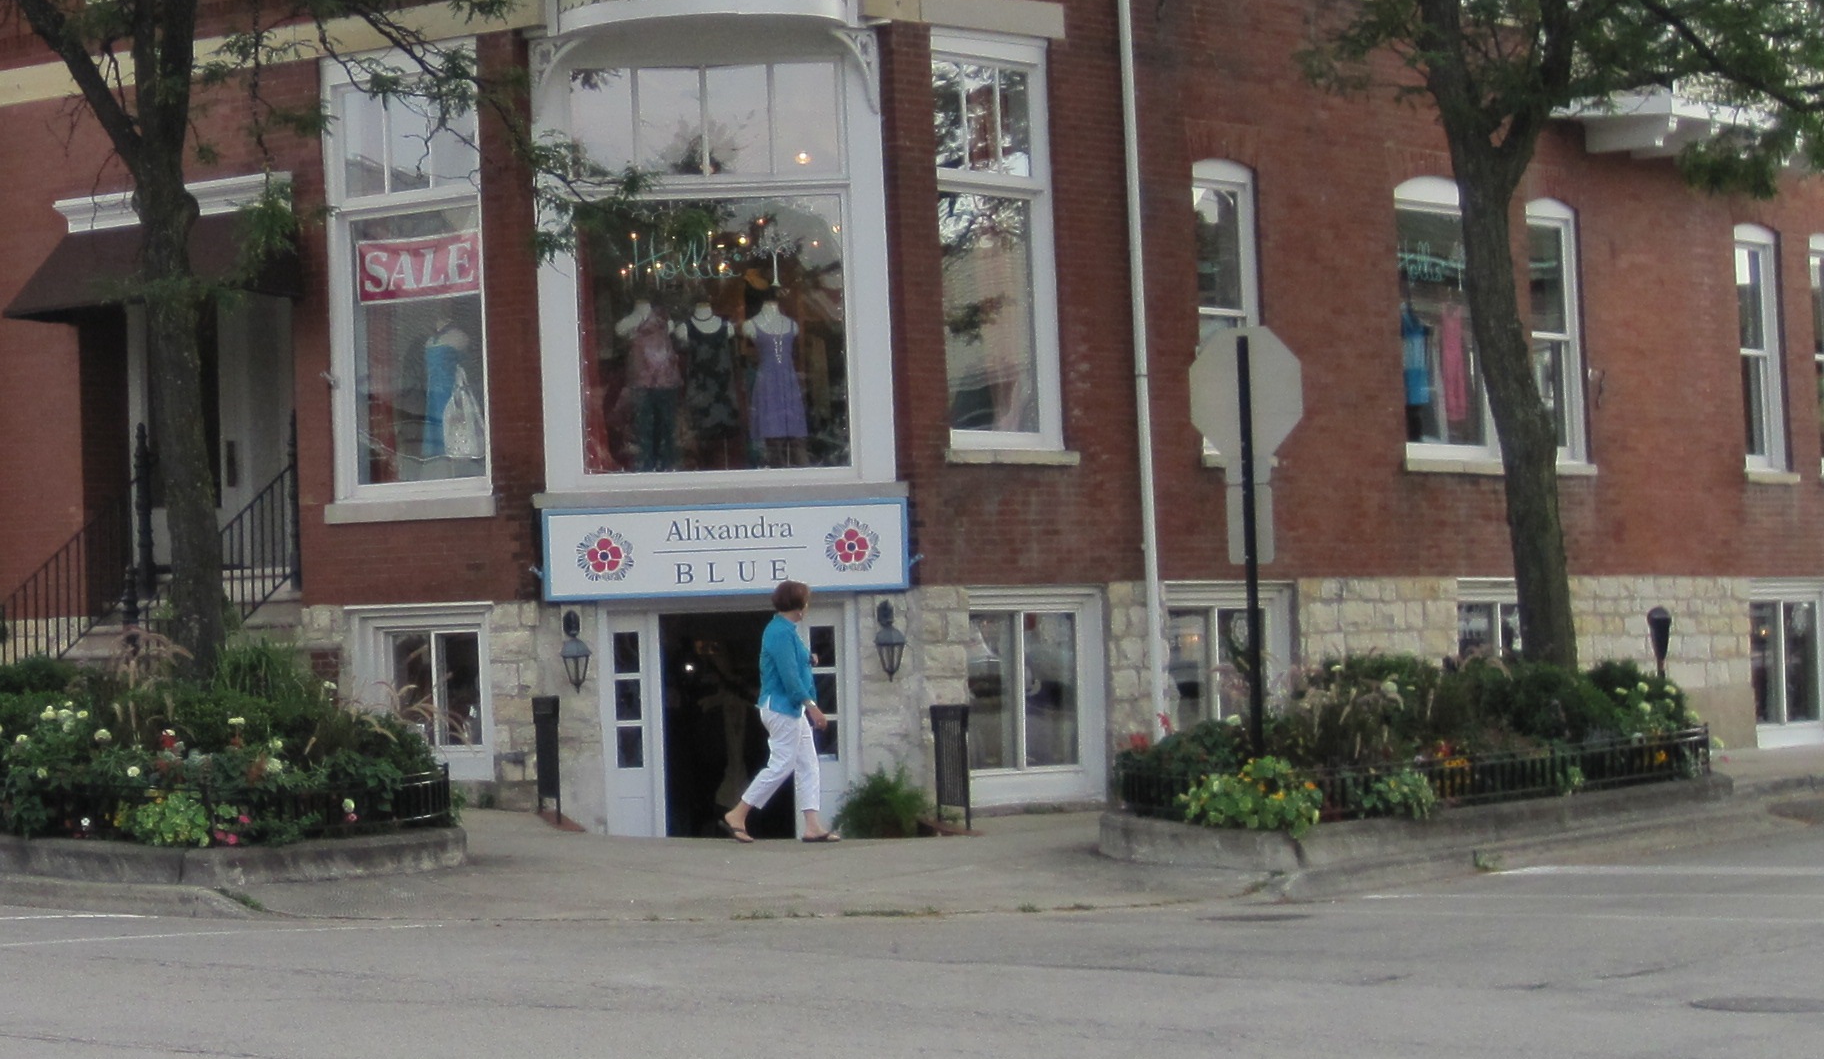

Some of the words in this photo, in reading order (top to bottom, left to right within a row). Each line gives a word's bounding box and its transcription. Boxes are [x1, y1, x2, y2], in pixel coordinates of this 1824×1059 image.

[364, 241, 475, 292] SALE
[666, 515, 793, 542] Alixandra
[674, 559, 790, 584] BLUE
